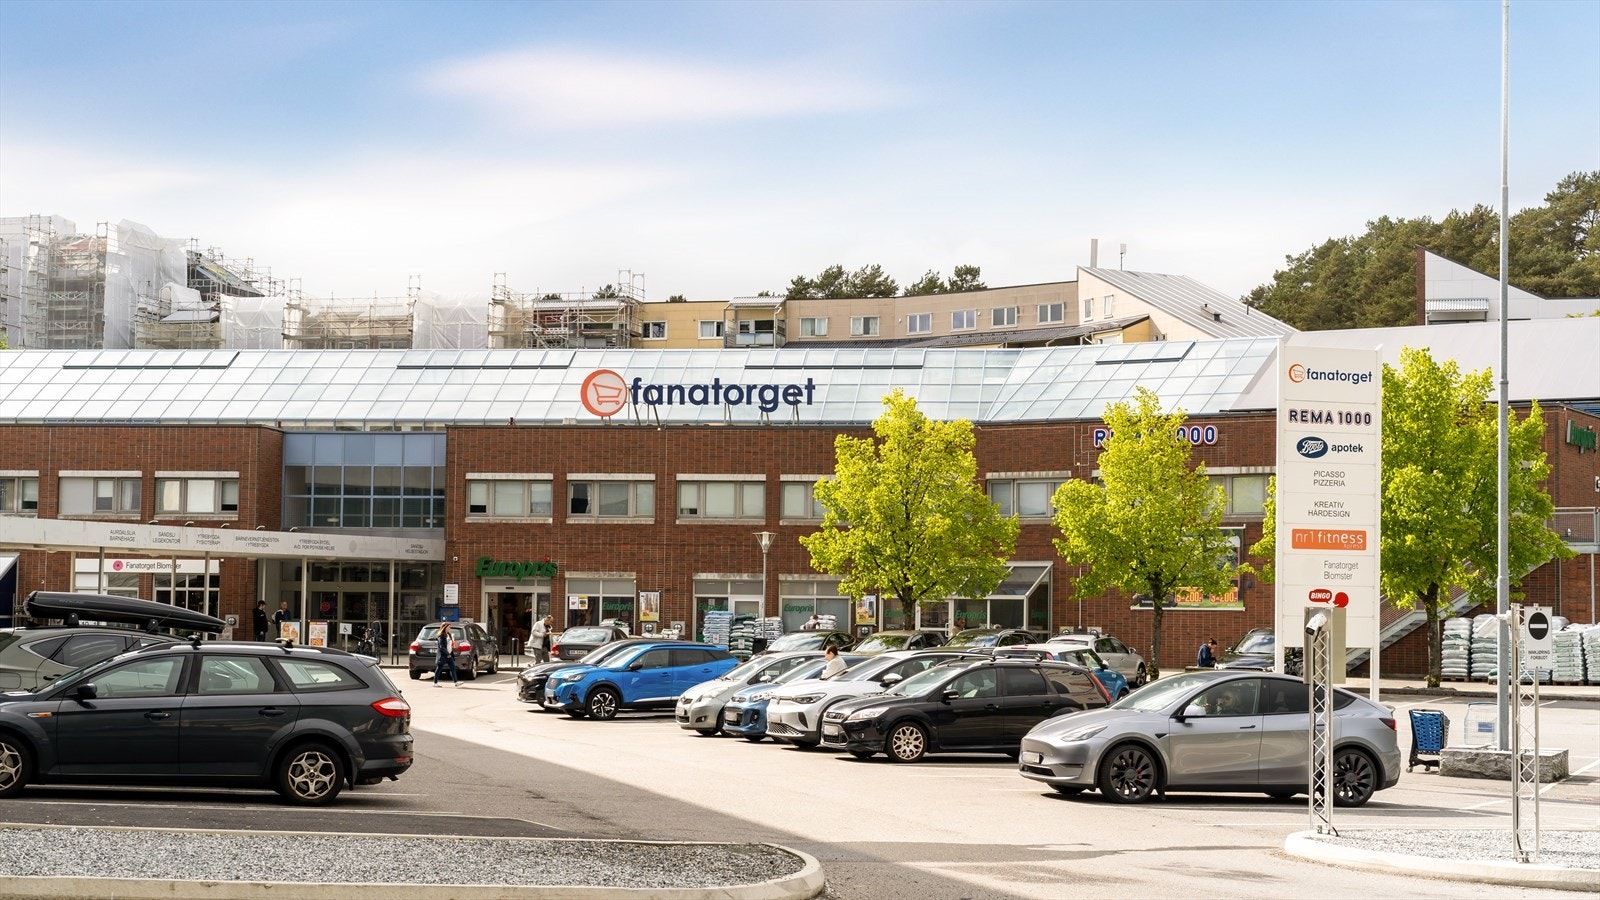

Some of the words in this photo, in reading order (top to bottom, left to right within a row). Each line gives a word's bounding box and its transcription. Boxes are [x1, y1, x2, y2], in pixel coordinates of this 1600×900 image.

[1306, 368, 1373, 385] fanatorget
[631, 377, 816, 412] fanatorget
[1288, 410, 1334, 424] REMA
[1338, 411, 1373, 426] 1000
[1331, 443, 1364, 453] apotek
[1313, 470, 1346, 478] PICASSO
[1313, 479, 1346, 487] PIZZERIA
[1313, 500, 1345, 508] KREATIV
[1295, 532, 1315, 543] nr1
[1317, 532, 1364, 544] fitness
[125, 562, 156, 570] Fanatorget
[475, 556, 558, 582] Europris
[1323, 561, 1359, 571] Fanatorget
[1323, 571, 1353, 580] Blomster
[1310, 592, 1331, 600] BINGO
[602, 602, 634, 611] Europris
[784, 604, 815, 613] Europris
[954, 609, 987, 620] Europris
